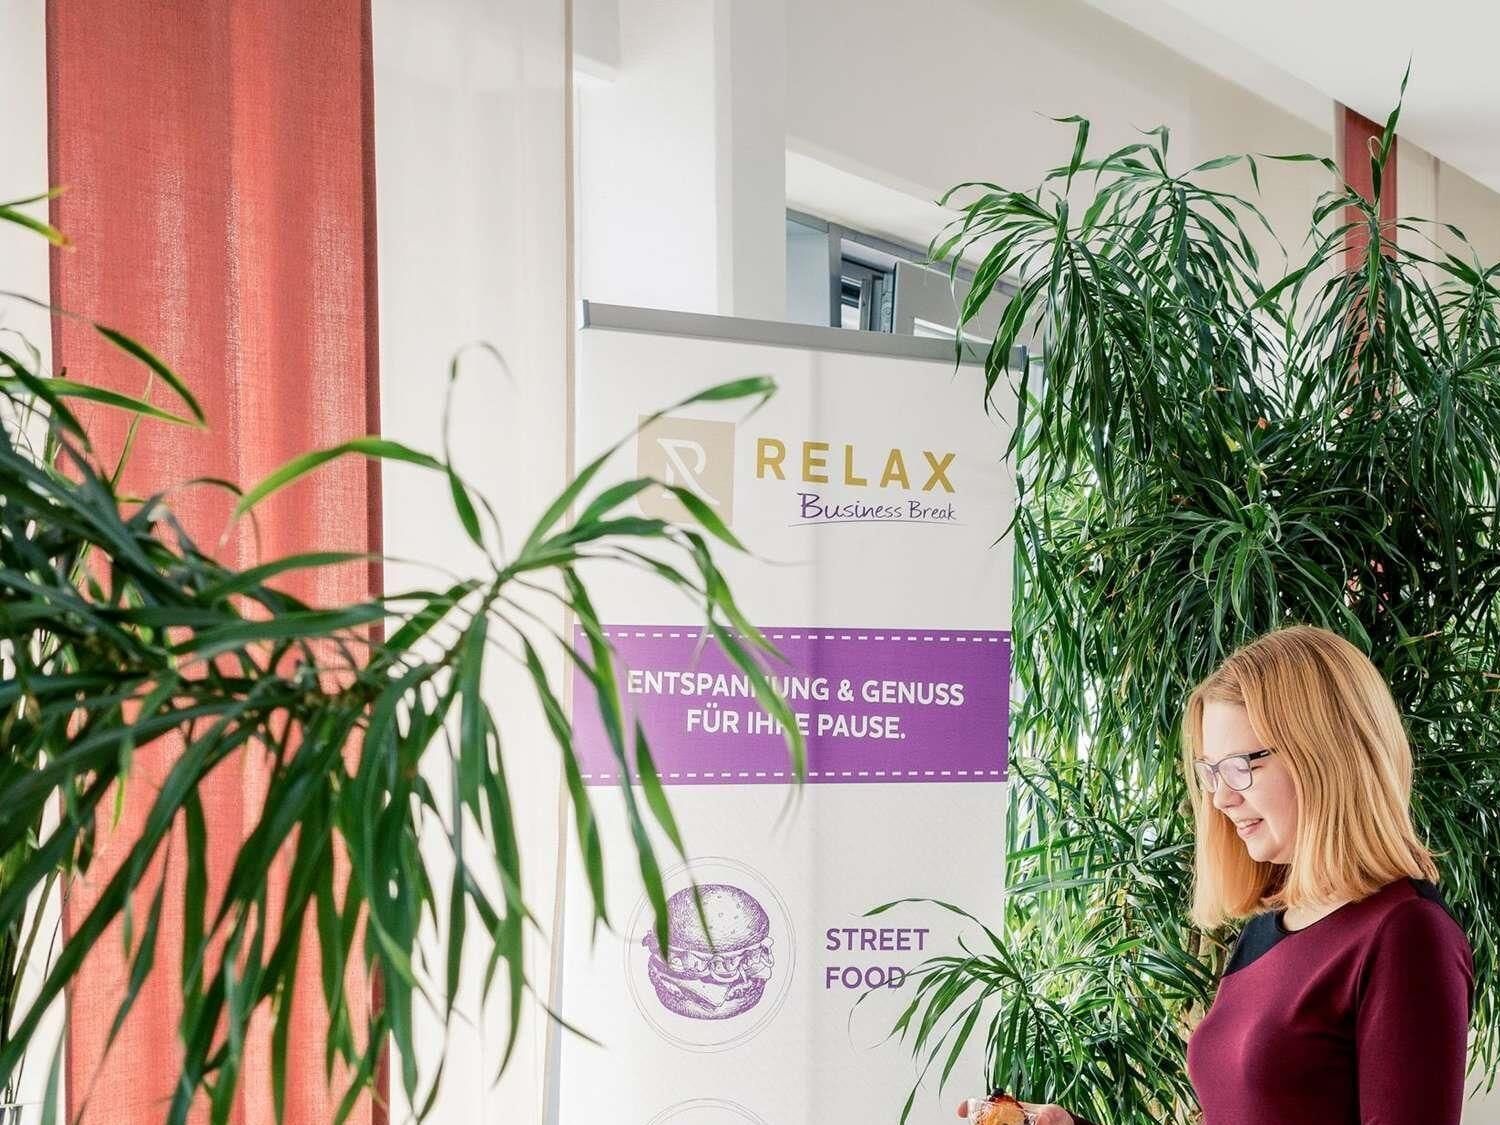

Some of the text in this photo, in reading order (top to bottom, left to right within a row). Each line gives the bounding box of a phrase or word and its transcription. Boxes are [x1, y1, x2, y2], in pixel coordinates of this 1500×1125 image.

[756, 437, 956, 493] RELAX
[797, 492, 957, 520] Business Break
[837, 679, 854, 702] &
[861, 680, 965, 706] GENUSS
[686, 702, 739, 734] FÜR
[817, 713, 906, 740] PAUSE.
[826, 928, 930, 951] STREET
[826, 966, 905, 990] FOOD
